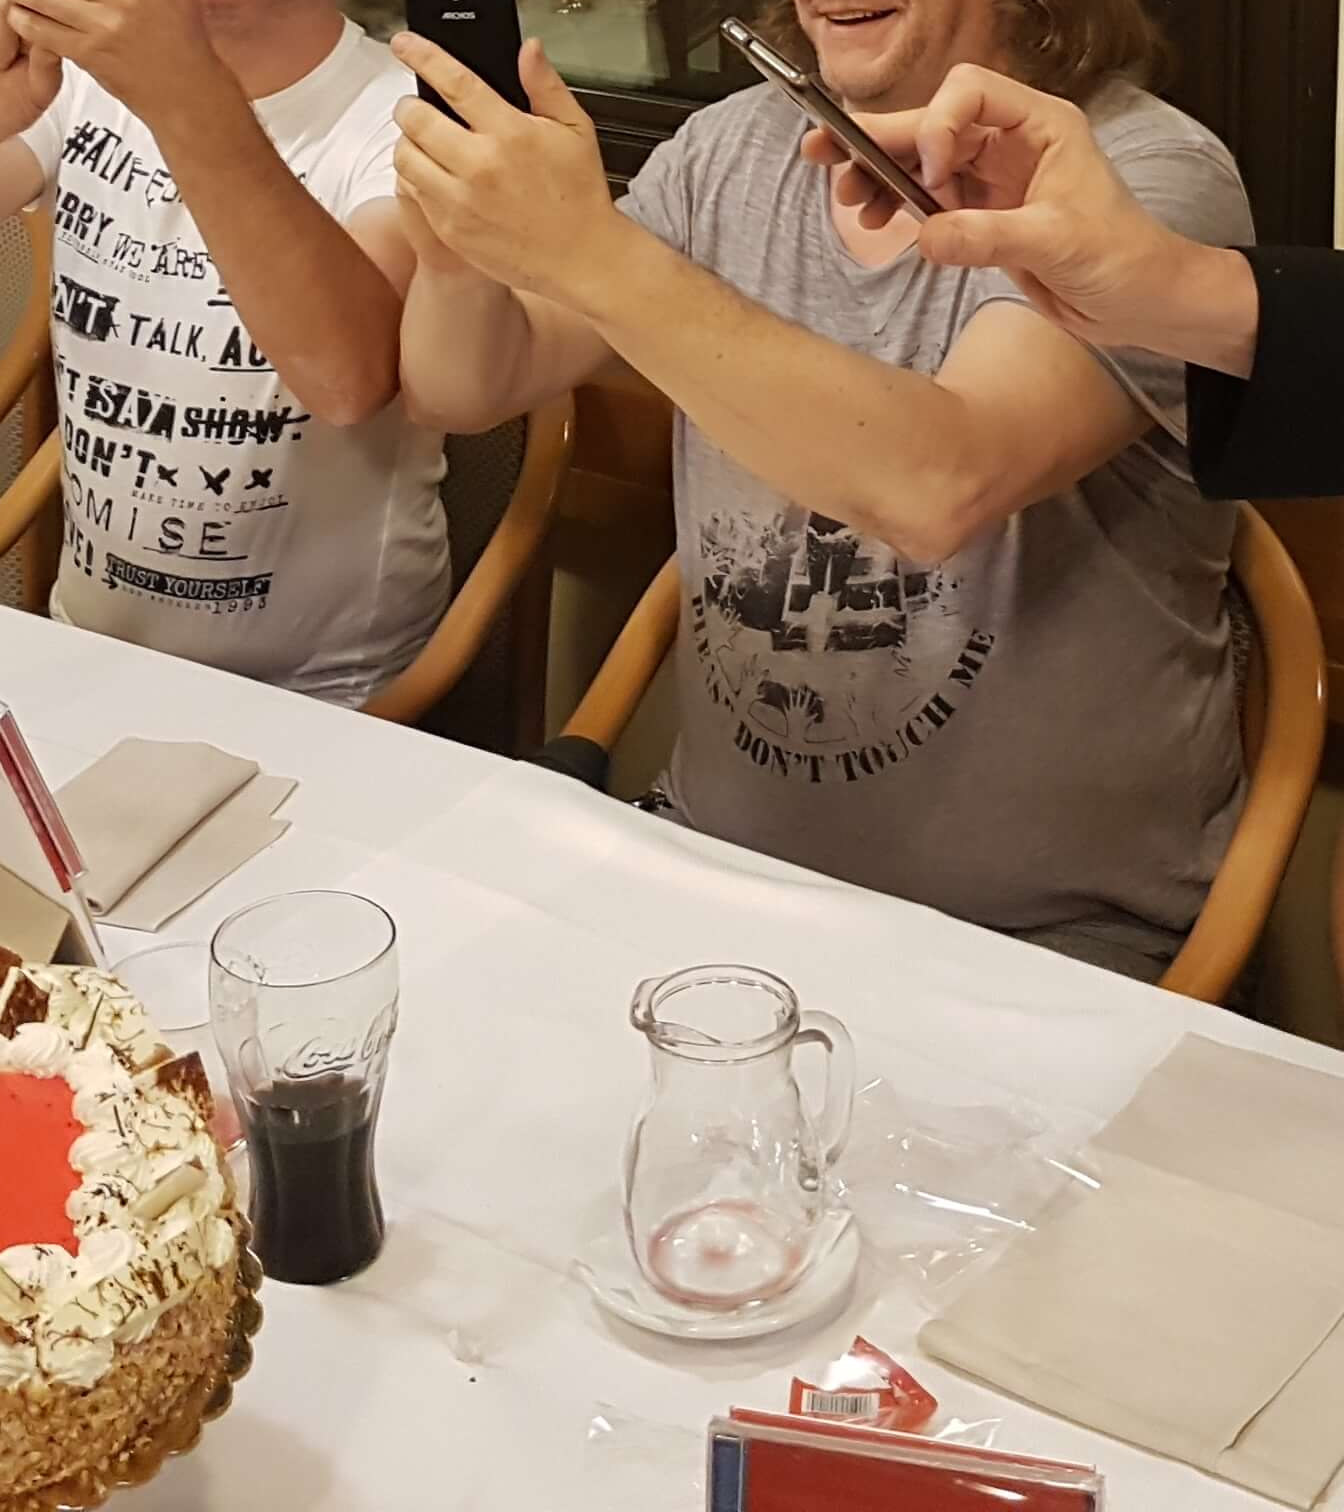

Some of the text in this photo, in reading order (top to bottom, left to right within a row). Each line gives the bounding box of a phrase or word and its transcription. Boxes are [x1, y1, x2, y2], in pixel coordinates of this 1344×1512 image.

[107, 555, 272, 601] TRUST YOURSELF
[733, 720, 824, 783] DON'T
[834, 692, 956, 783] TOUCH
[947, 628, 996, 689] ME
